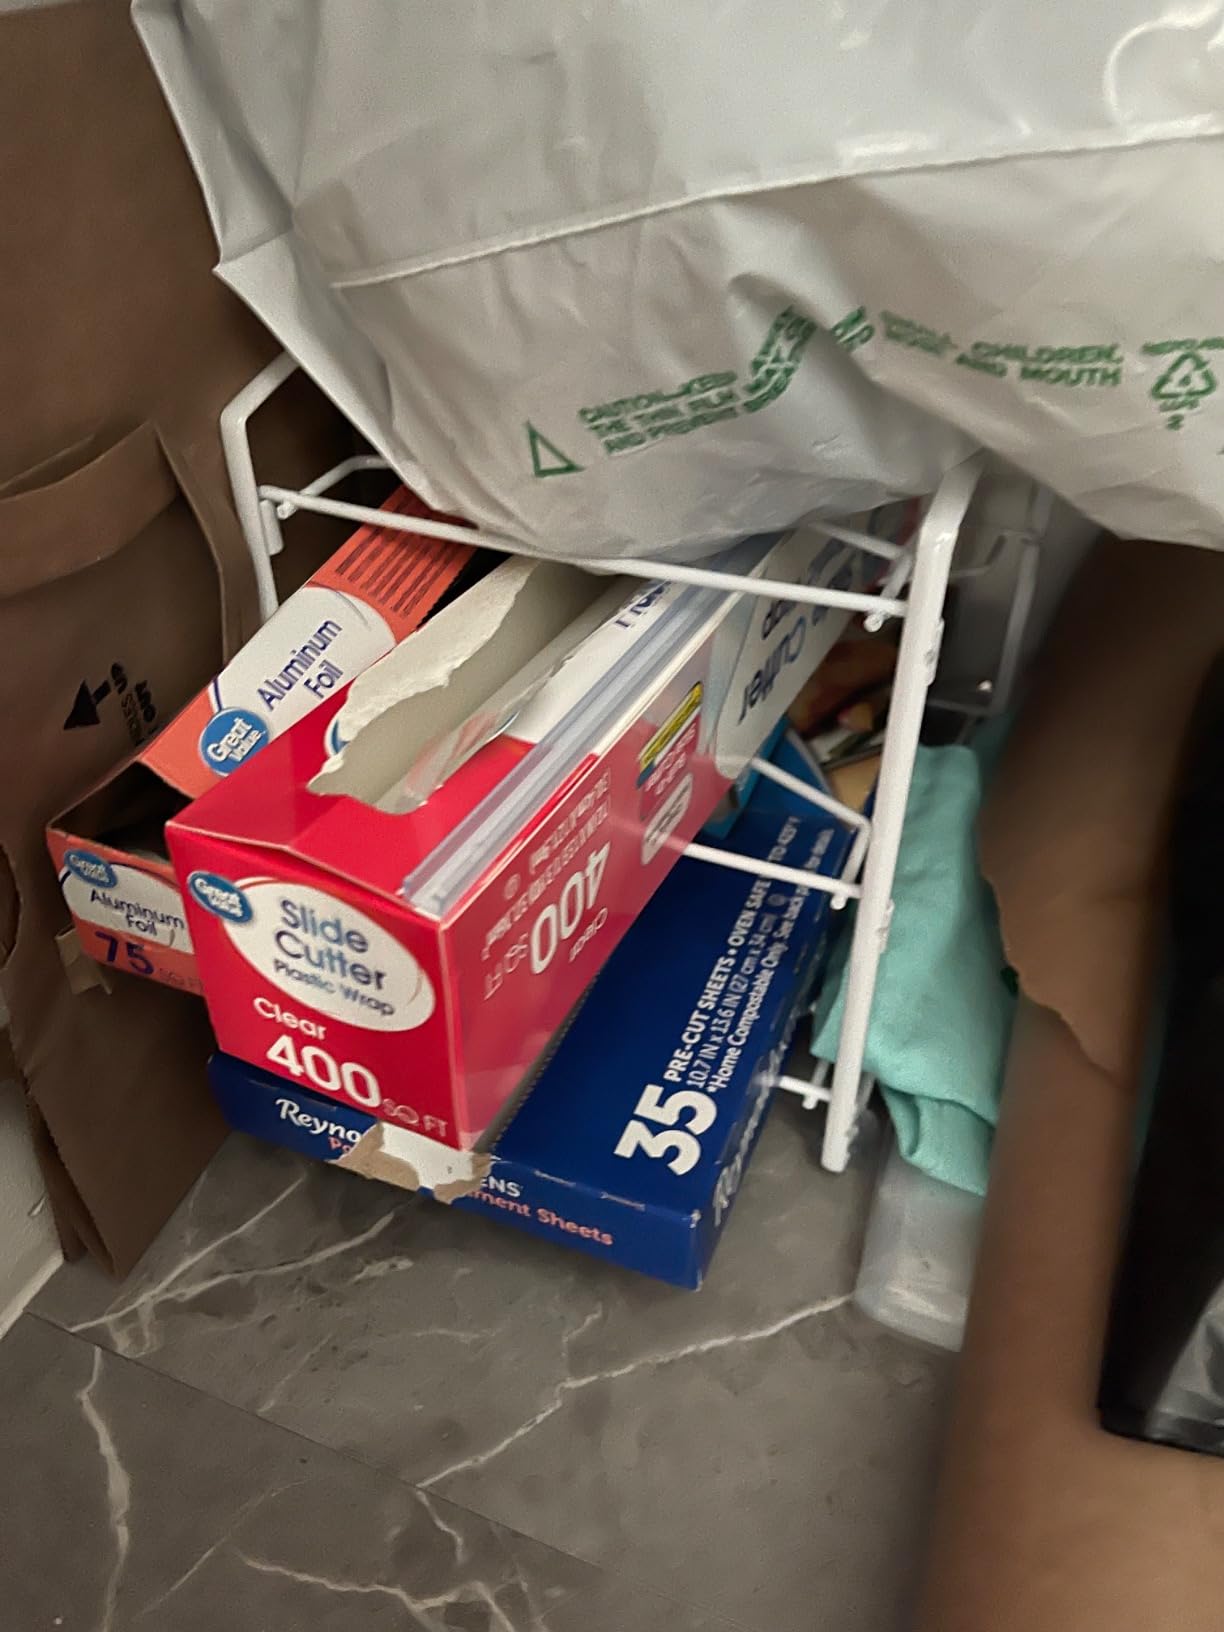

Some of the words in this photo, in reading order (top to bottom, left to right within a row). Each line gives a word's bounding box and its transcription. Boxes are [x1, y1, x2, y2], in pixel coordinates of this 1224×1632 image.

[1019, 365, 1122, 387] MOUTH
[257, 620, 343, 711] Aluminum
[303, 659, 344, 698] Foil
[738, 615, 807, 725] Cutter
[207, 716, 253, 762] Great
[230, 728, 268, 763] Value
[90, 888, 185, 929] Aluminum
[126, 914, 157, 936] Foil
[281, 899, 369, 954] Slide
[530, 840, 611, 975] 400
[95, 931, 154, 975] 75
[568, 907, 608, 964] Clear
[275, 929, 387, 991] Cutter
[663, 1009, 710, 1082] PRE-CUT
[697, 956, 737, 1010] SHEETS
[727, 910, 757, 947] OVEN
[745, 873, 772, 909] SAFE
[273, 959, 337, 995] Plastic
[340, 983, 396, 1017] Wrap
[721, 993, 743, 1008] IN
[727, 968, 776, 1047] Compostable
[253, 997, 327, 1041] Clear
[686, 1059, 711, 1089] 10.7
[697, 1043, 721, 1060] IN
[266, 1034, 382, 1109] 400
[381, 1098, 420, 1126] SQ
[423, 1114, 449, 1138] FT
[613, 1084, 718, 1176] 35
[536, 1208, 614, 1246] Sheets
